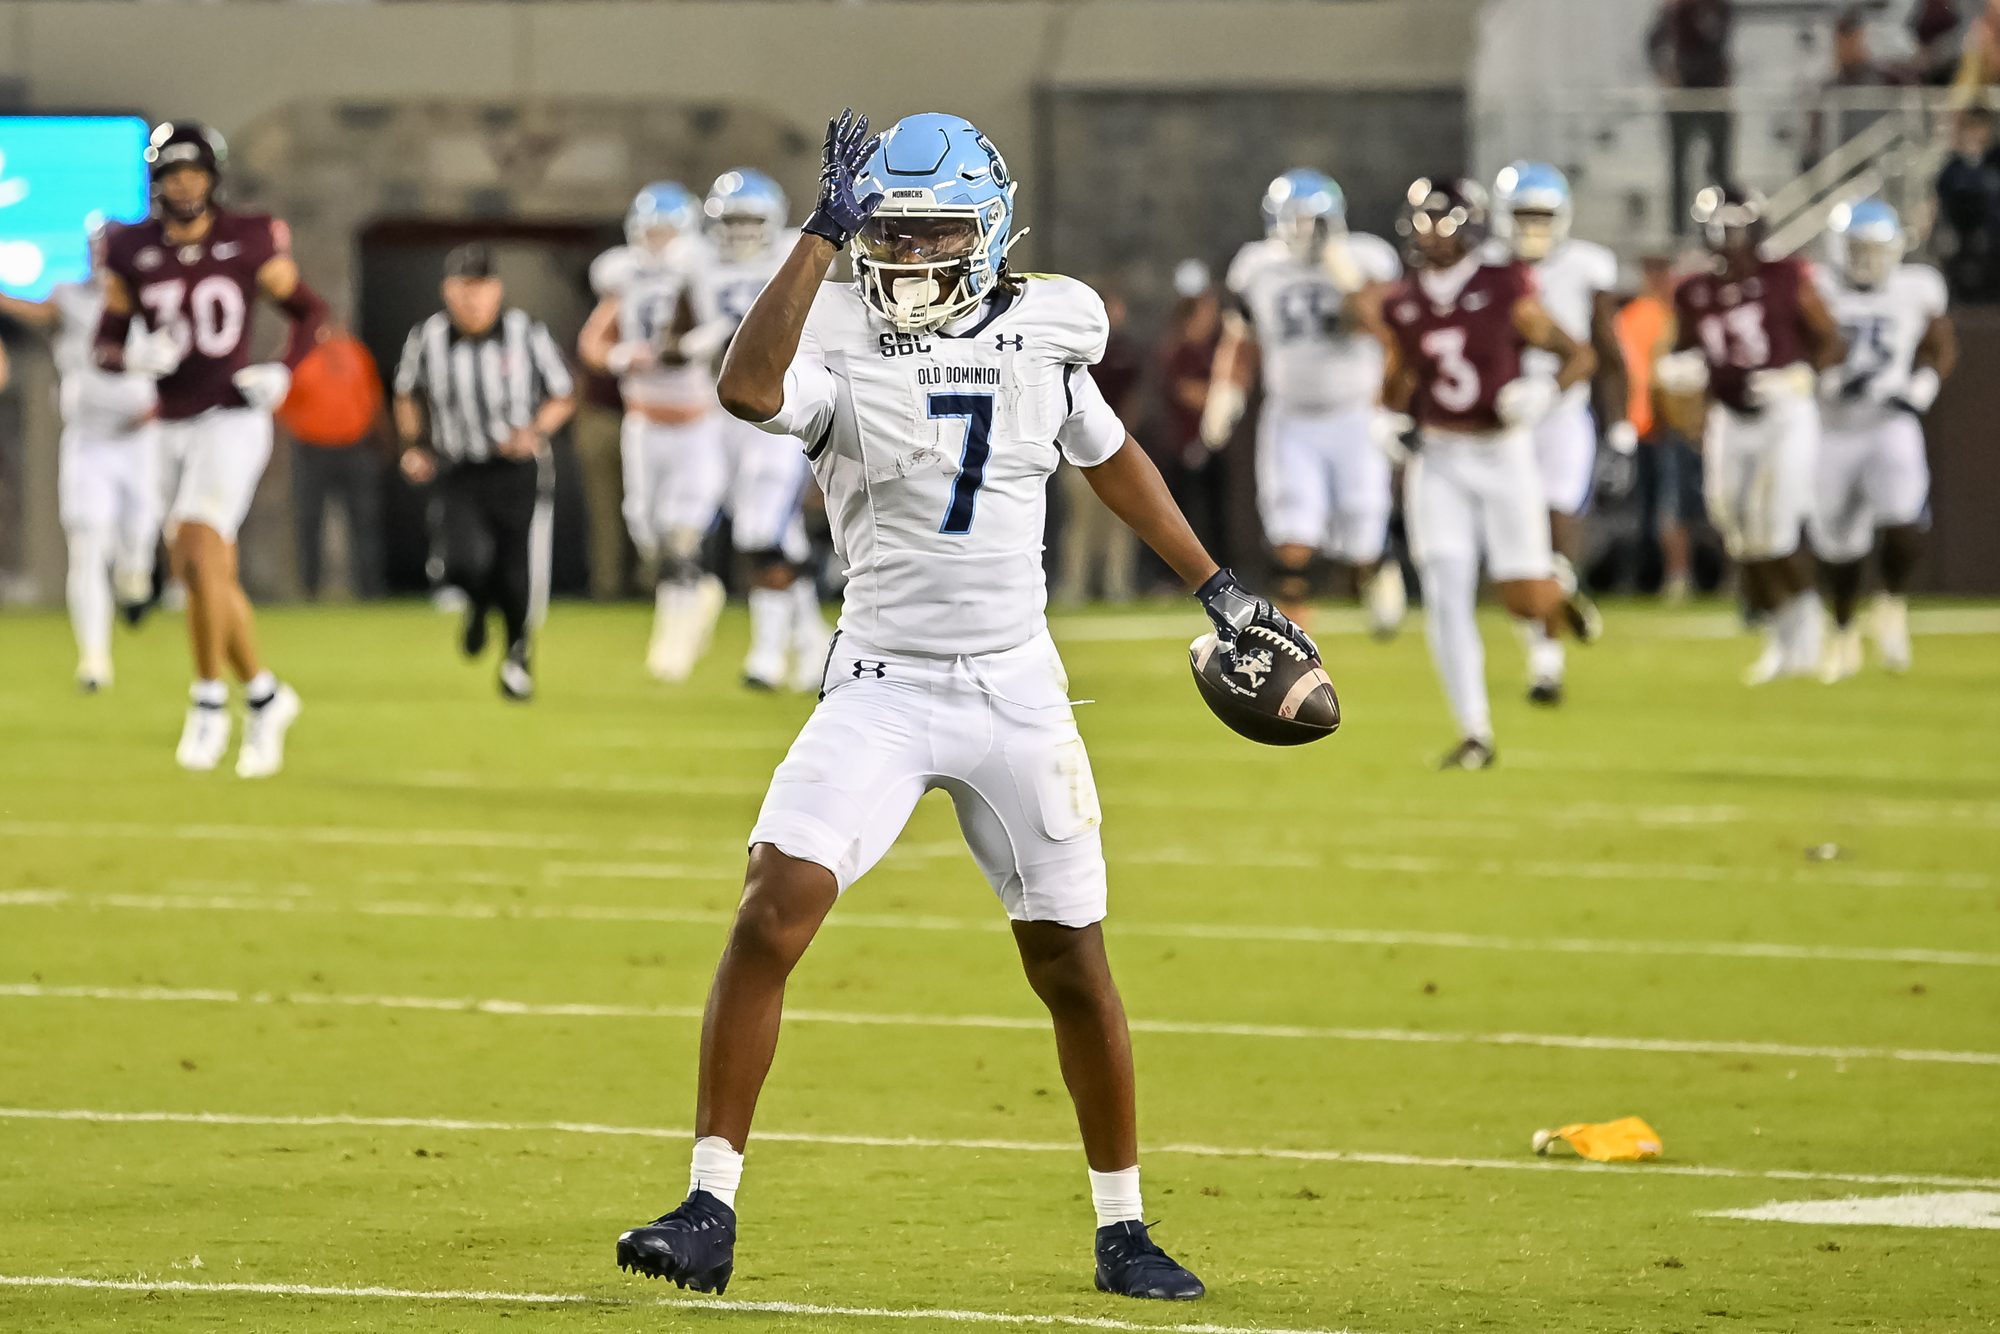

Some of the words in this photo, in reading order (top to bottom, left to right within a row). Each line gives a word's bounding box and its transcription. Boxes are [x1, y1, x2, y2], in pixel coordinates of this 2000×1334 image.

[892, 190, 923, 199] MONARCHS
[139, 275, 247, 359] 30
[879, 331, 932, 358] SBC
[918, 367, 941, 385] OLD
[1420, 326, 1482, 413] 3
[927, 391, 996, 535] 7
